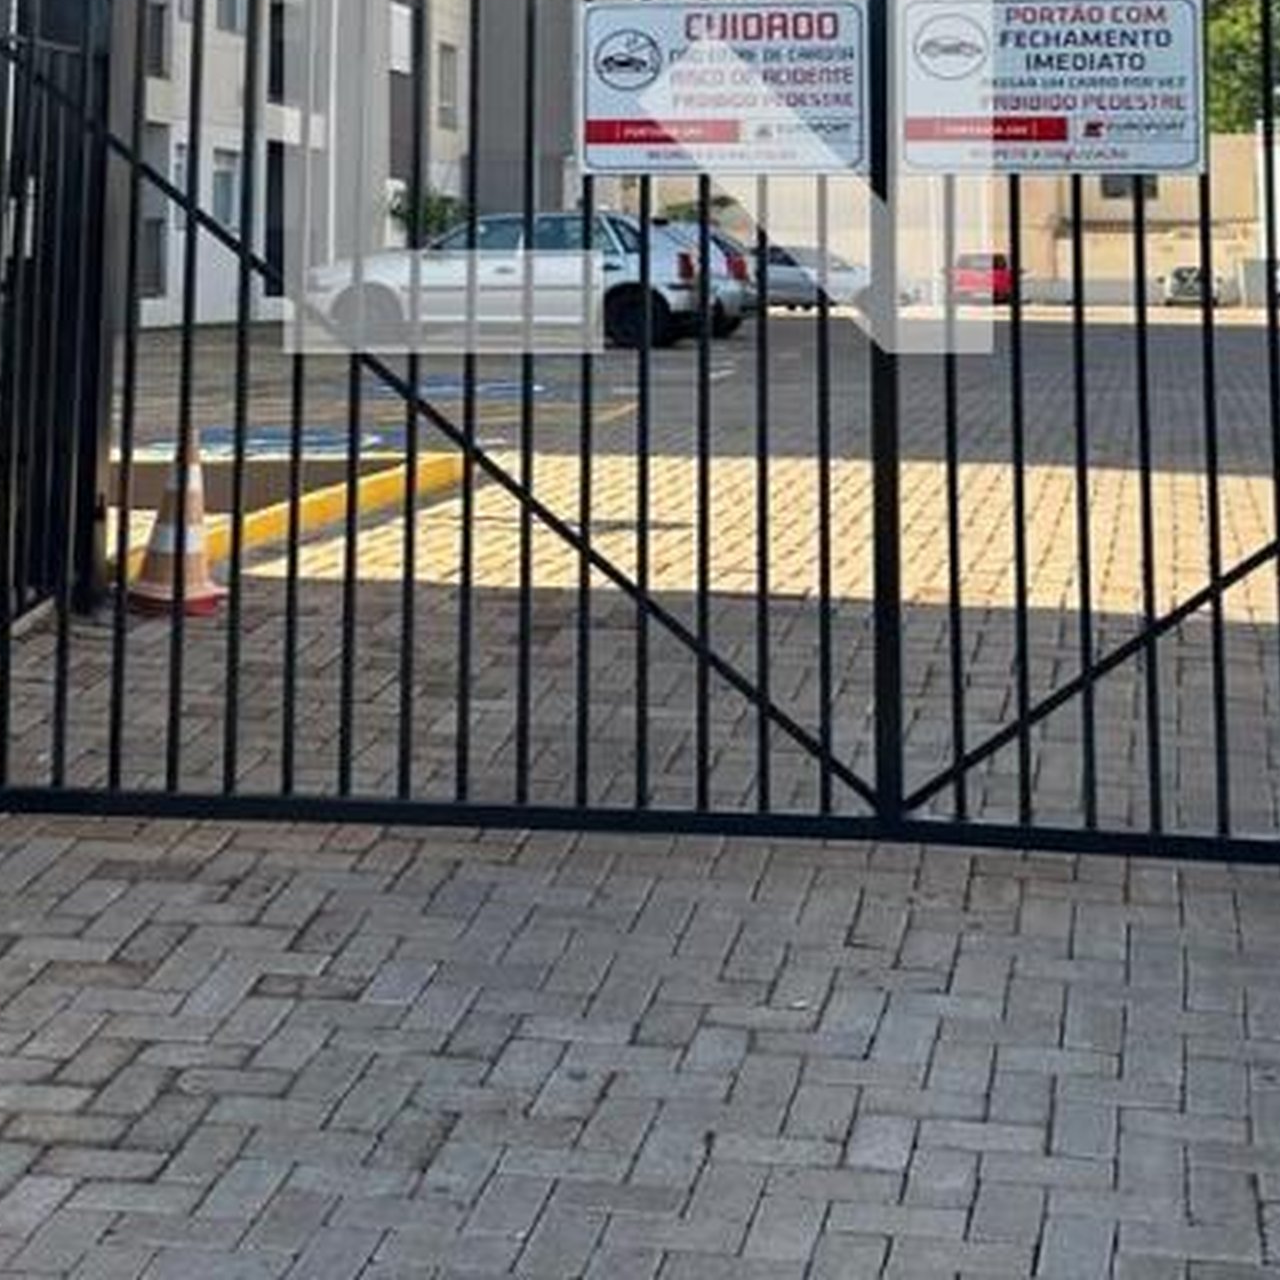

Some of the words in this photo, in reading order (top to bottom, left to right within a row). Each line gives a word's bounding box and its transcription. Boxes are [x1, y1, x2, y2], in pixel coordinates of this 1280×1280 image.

[1005, 3, 1105, 24] PORTÃO
[1111, 5, 1167, 23] COM
[684, 11, 839, 41] CUIDADO
[998, 29, 1173, 48] FECHAMENTO
[1024, 52, 1147, 71] IMEDIATO
[762, 66, 855, 85] ACIDENTE
[1082, 93, 1187, 110] PEDESTRE
